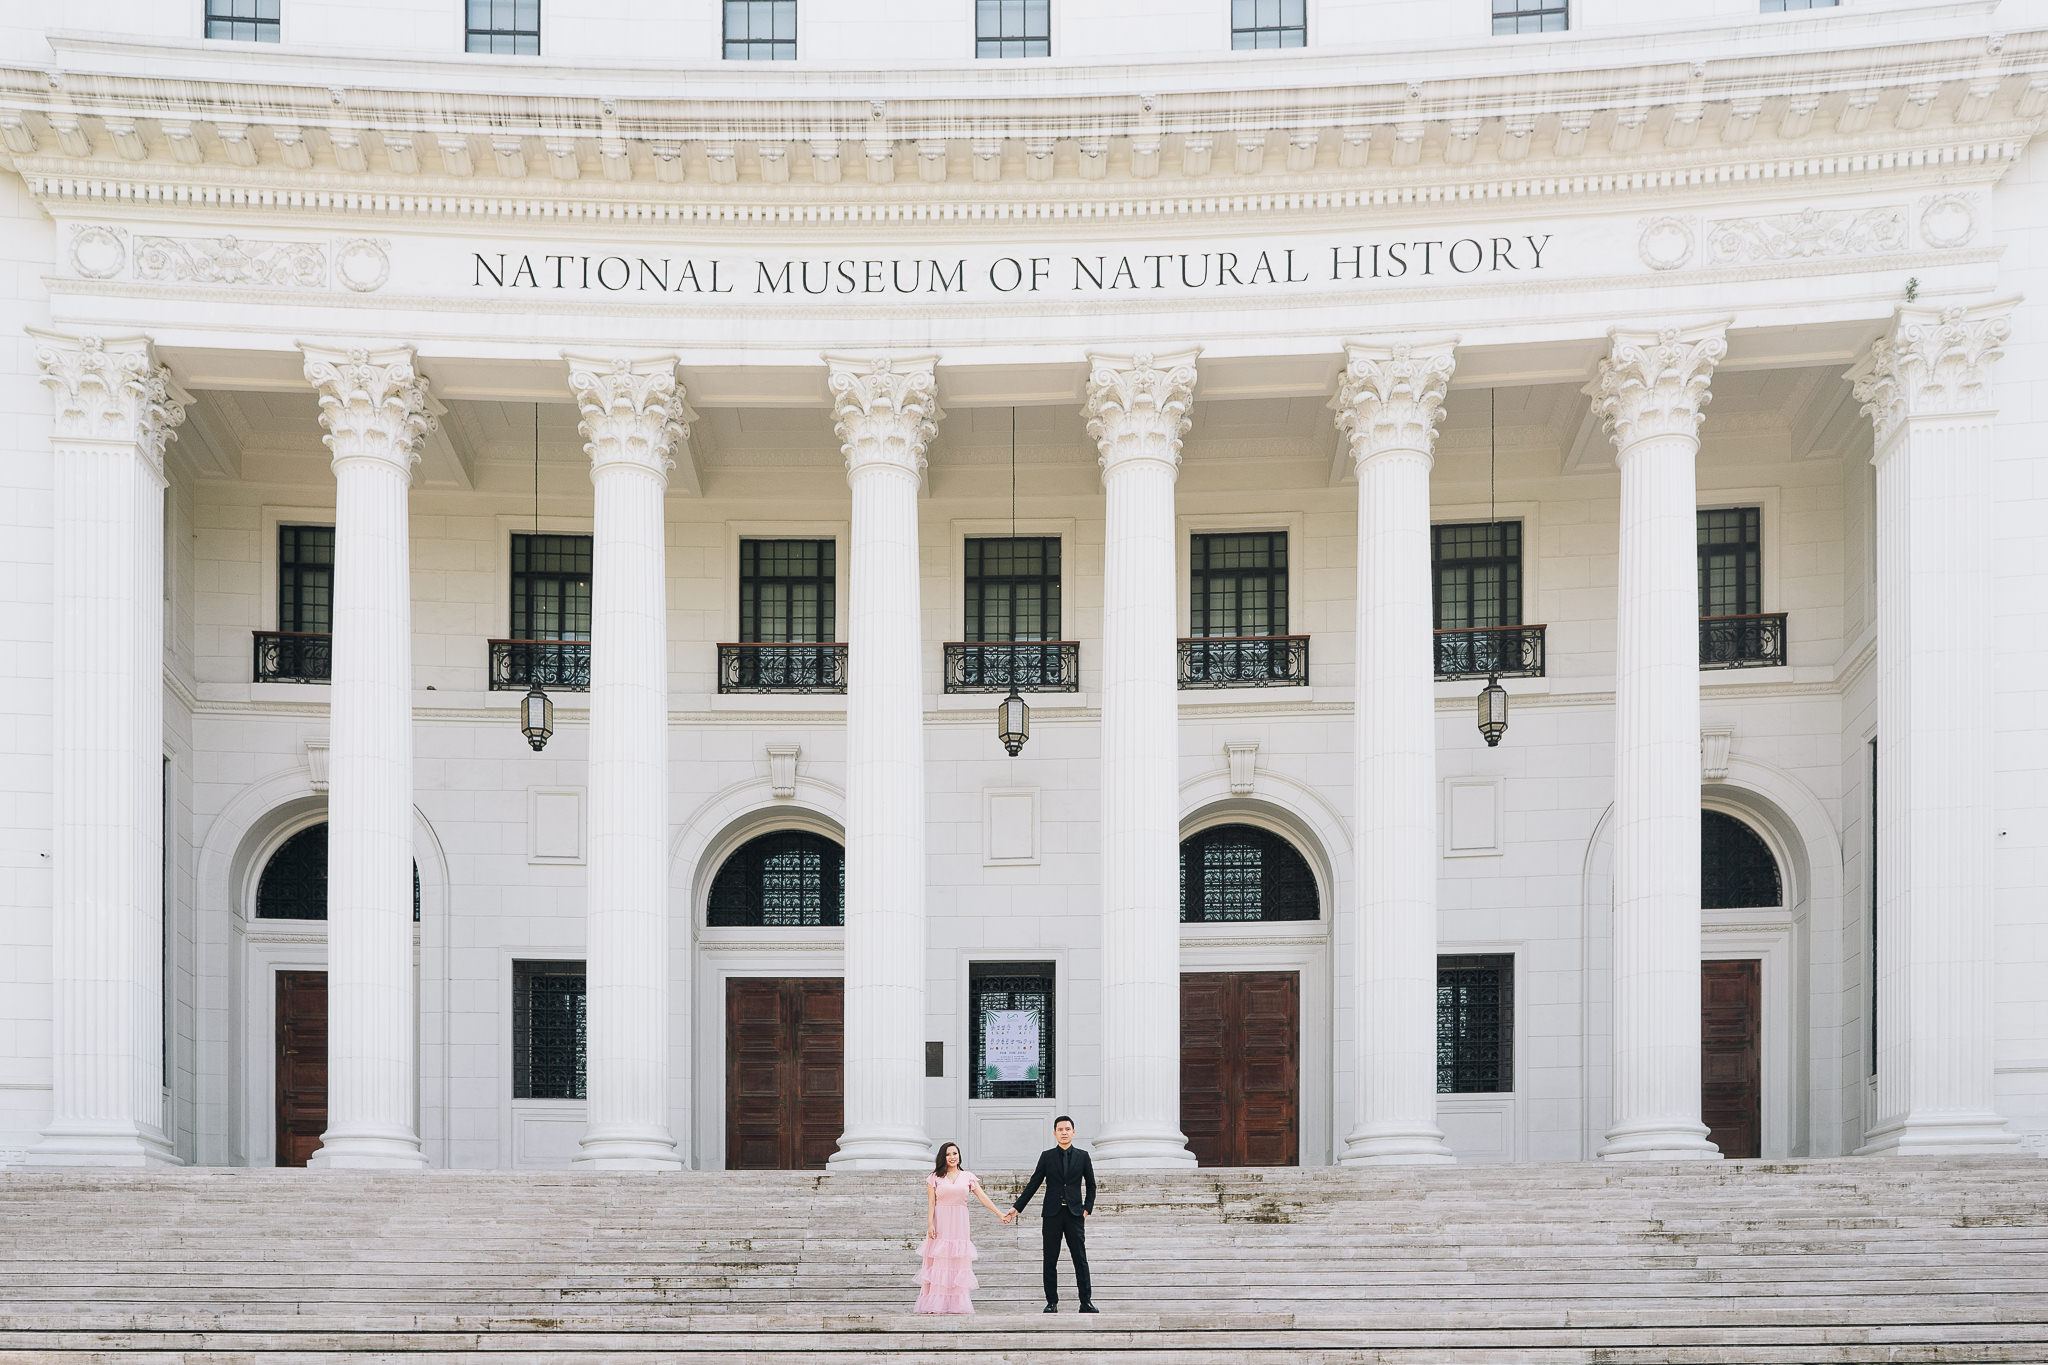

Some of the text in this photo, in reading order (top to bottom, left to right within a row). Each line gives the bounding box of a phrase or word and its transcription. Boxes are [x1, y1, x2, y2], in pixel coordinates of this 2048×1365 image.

[473, 234, 1553, 294] NATIONAL MUSEUM OF NATURAL HISTORY
